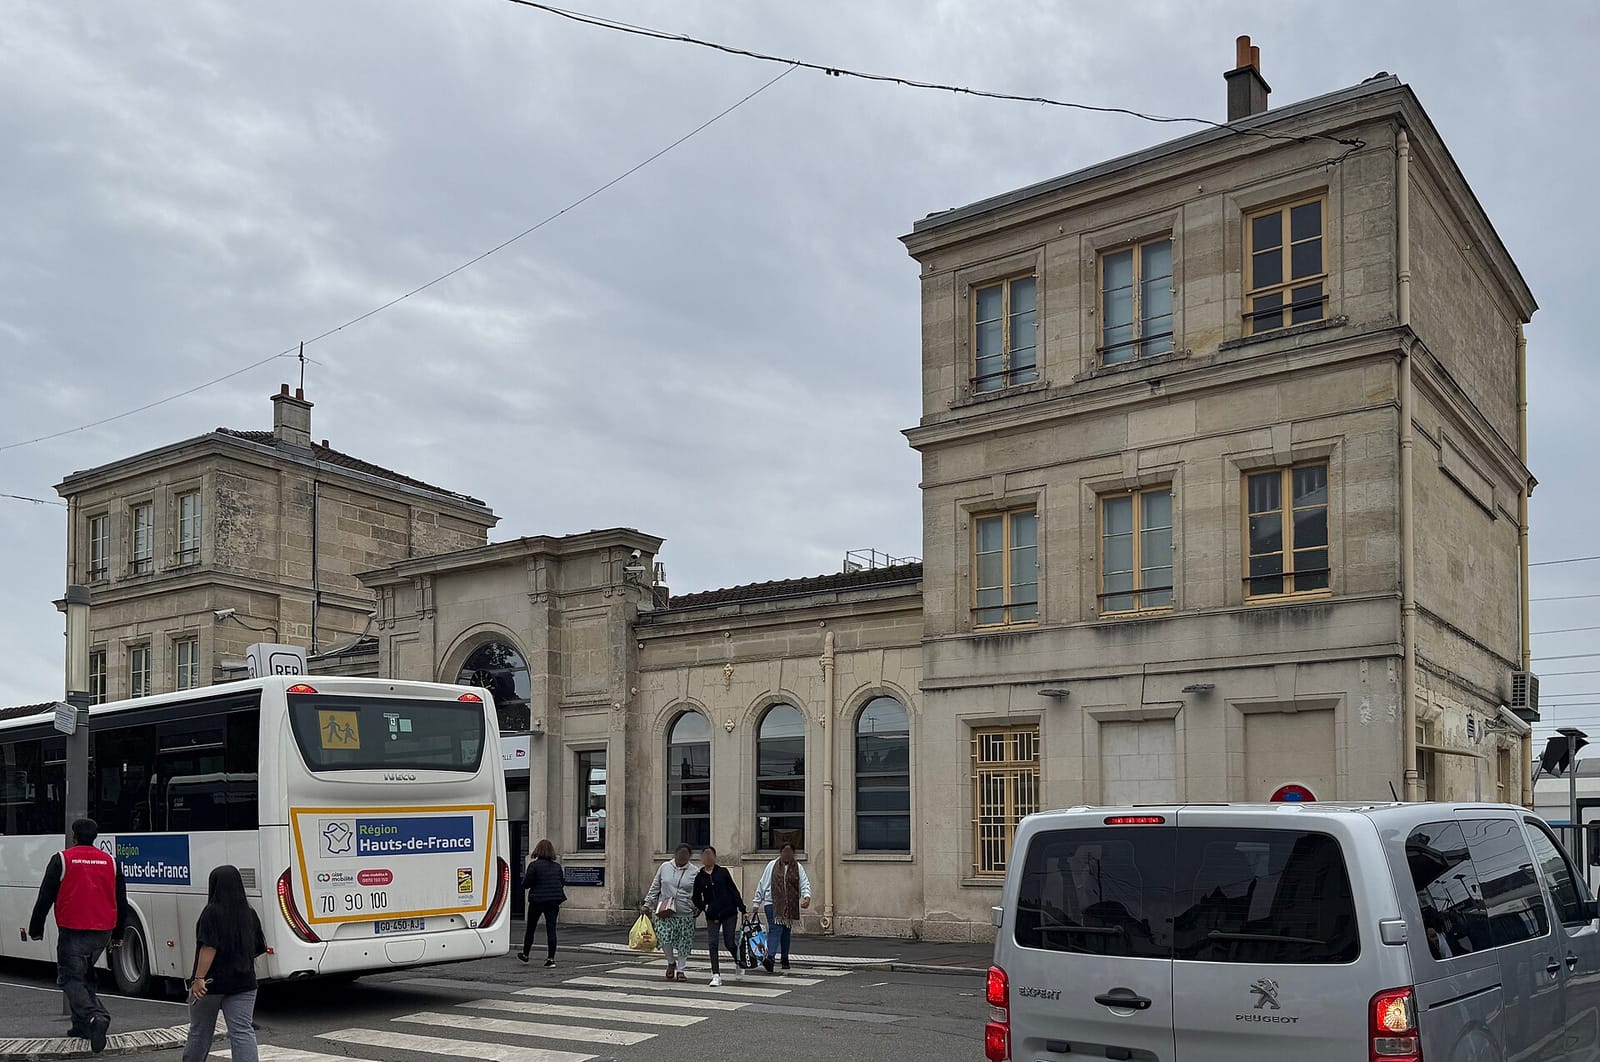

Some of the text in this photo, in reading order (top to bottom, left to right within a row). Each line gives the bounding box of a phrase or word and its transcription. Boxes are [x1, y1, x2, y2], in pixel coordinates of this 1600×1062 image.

[275, 665, 299, 676] RER
[383, 773, 416, 781] IVECO
[359, 824, 398, 836] Région
[116, 843, 140, 858] Région
[359, 836, 472, 852] Hauts-de-France
[320, 891, 388, 913] 70 90 100
[1018, 986, 1062, 1000] EXPERT
[1235, 1014, 1299, 1024] PEUGEOT
